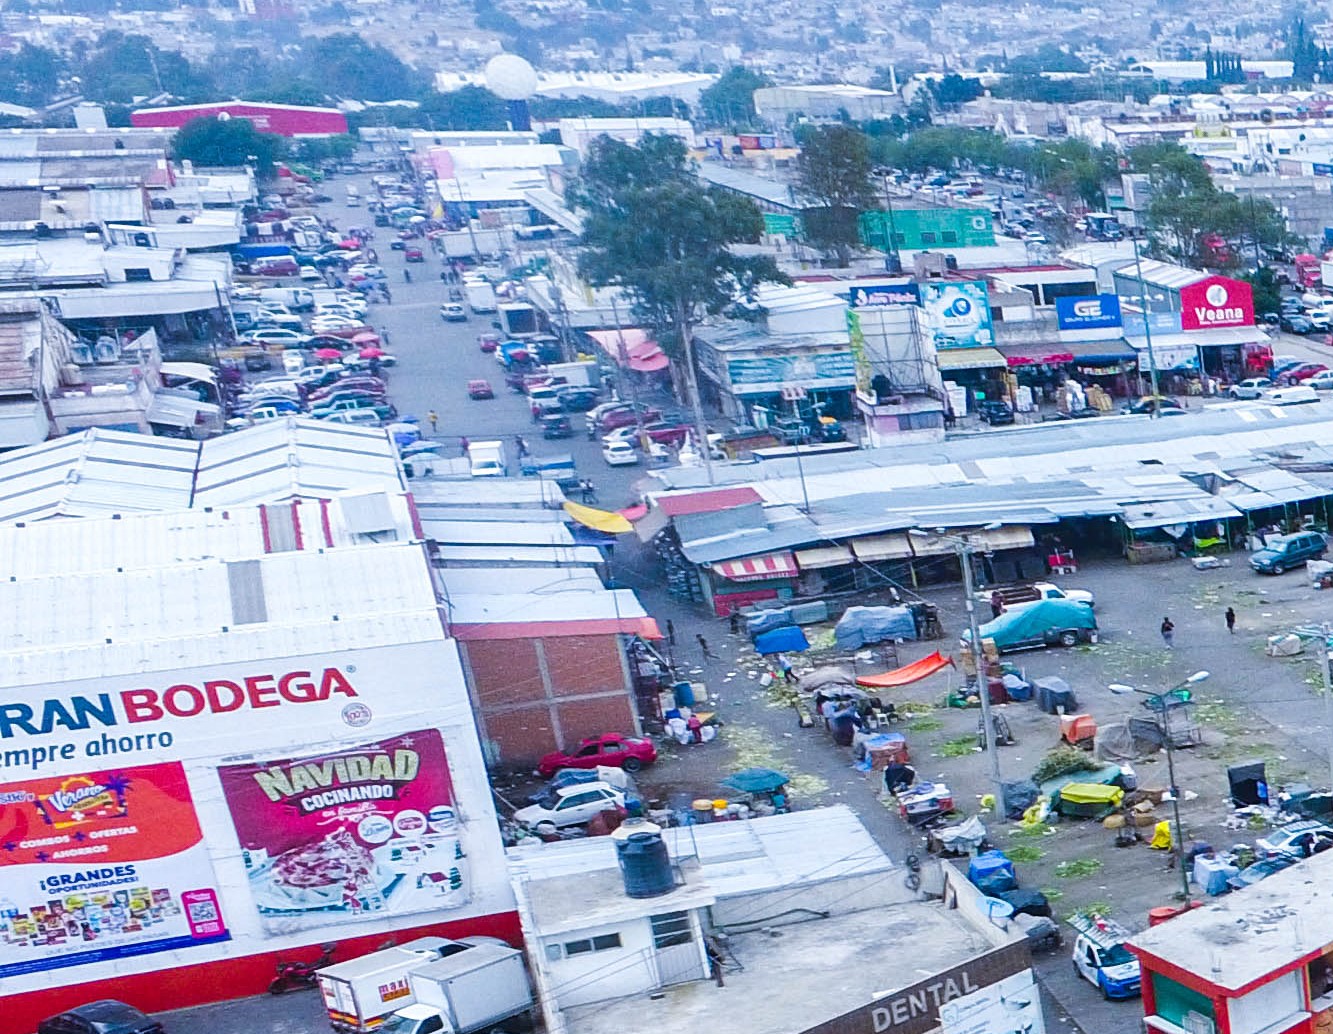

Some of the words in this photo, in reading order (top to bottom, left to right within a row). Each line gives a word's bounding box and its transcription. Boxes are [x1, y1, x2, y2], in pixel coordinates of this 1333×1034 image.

[120, 667, 359, 723] BODEGA
[0, 743, 75, 770] mpre
[85, 731, 173, 758] ahorro
[253, 749, 420, 802] NAVIDAD
[49, 785, 107, 812] Verano
[301, 785, 394, 812] COCINANDO
[89, 826, 139, 839] OFERTAS
[53, 844, 109, 860] AHORROS
[39, 864, 136, 891] ¡GRANDES
[872, 971, 979, 1033] DENTAL
